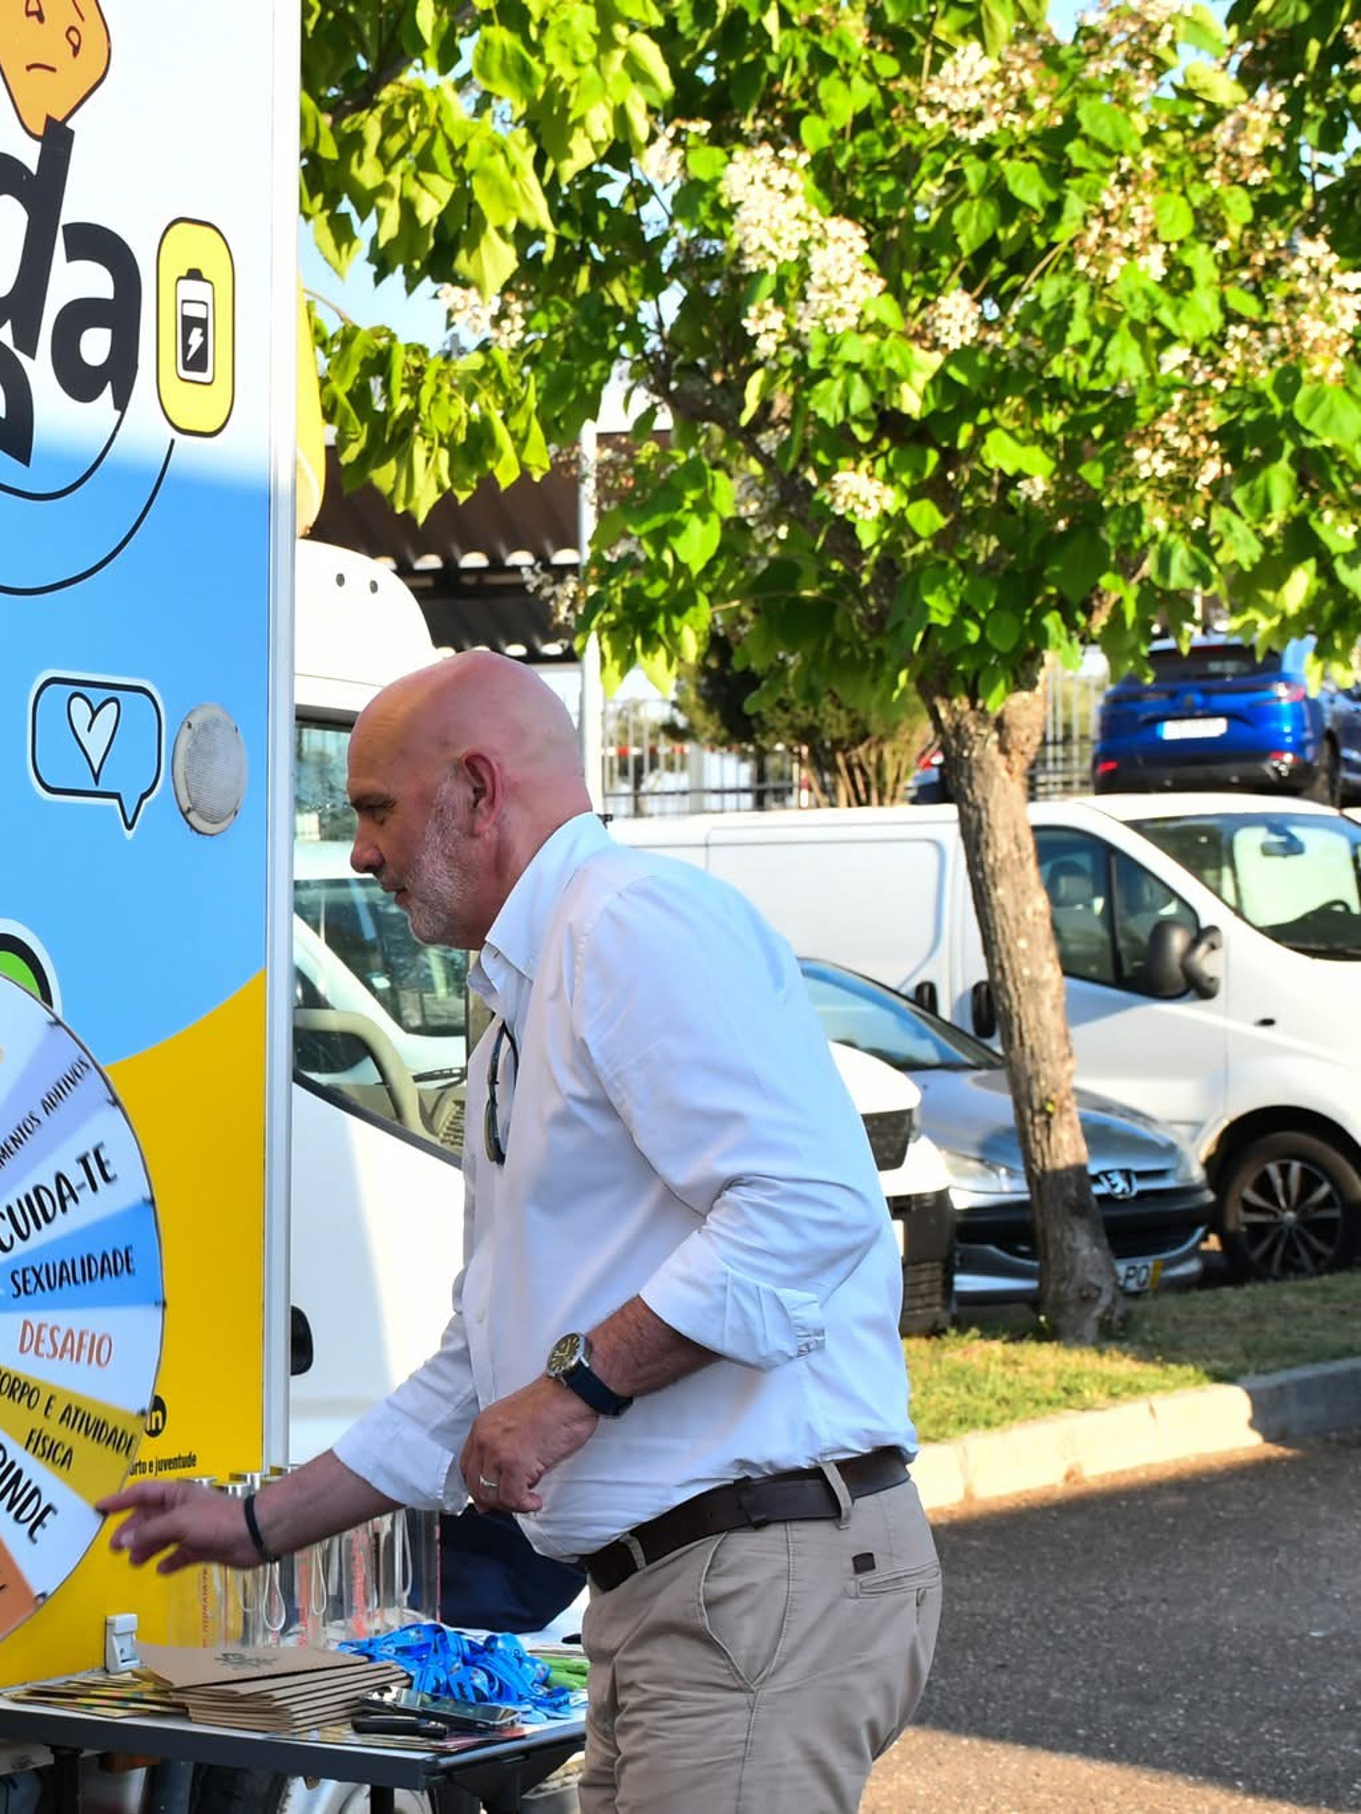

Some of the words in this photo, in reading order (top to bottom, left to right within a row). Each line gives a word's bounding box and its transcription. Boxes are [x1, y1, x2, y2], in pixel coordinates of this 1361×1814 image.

[41, 1055, 91, 1116] ADITIVOS
[10, 1245, 136, 1299] SEXUALIDADE
[18, 1319, 113, 1368] DESAFIO
[25, 1427, 74, 1472] FÍSICA
[44, 1393, 54, 1416] E
[59, 1403, 137, 1458] ATIVIDADE
[148, 1461, 154, 1473] e
[155, 1452, 197, 1476] juventude
